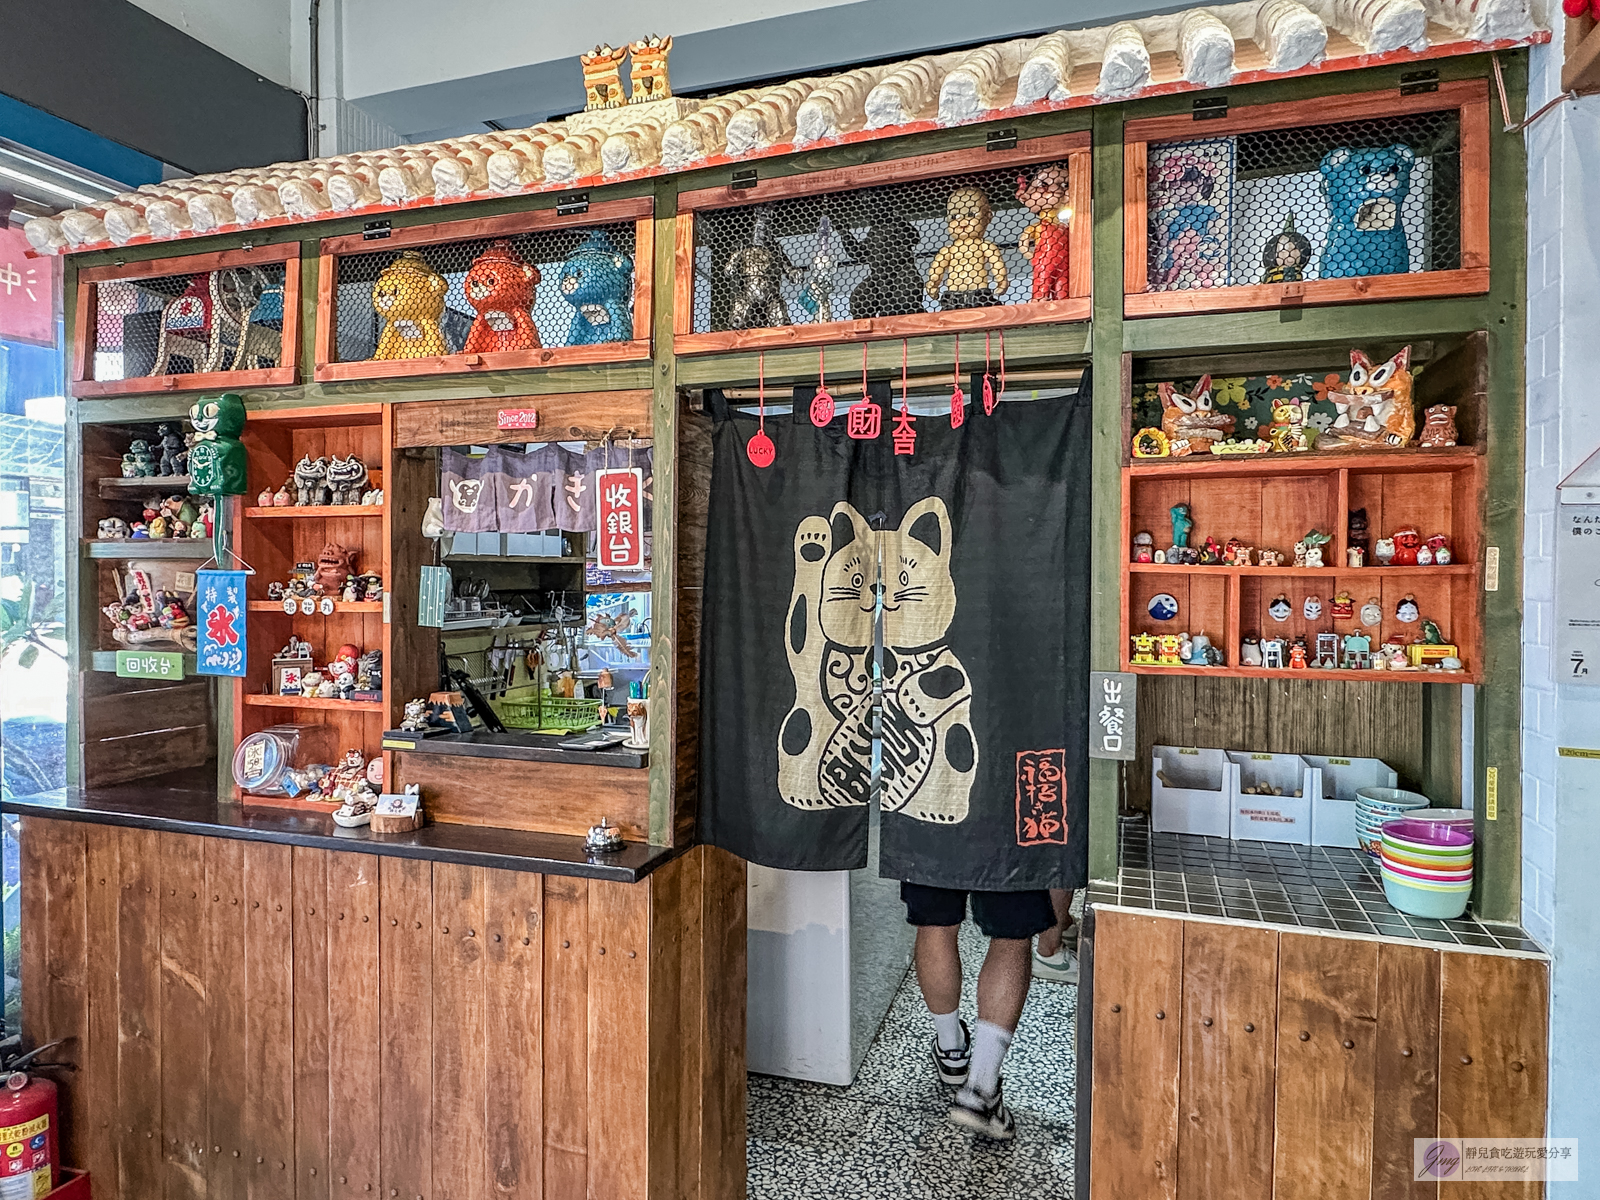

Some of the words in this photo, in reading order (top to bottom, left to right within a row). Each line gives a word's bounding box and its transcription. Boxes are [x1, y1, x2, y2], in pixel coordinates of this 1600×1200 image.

[498, 411, 519, 426] Since
[851, 406, 875, 434] 財
[892, 416, 917, 455] 大吉
[749, 447, 773, 455] LUCKY
[605, 483, 633, 563] 收銀台
[205, 586, 239, 605] 特製
[285, 601, 333, 613] 浪花丸
[206, 604, 239, 647] 氷
[126, 656, 171, 675] 回收台
[1099, 678, 1125, 752] 出餐口
[1560, 749, 1589, 757] 120cm
